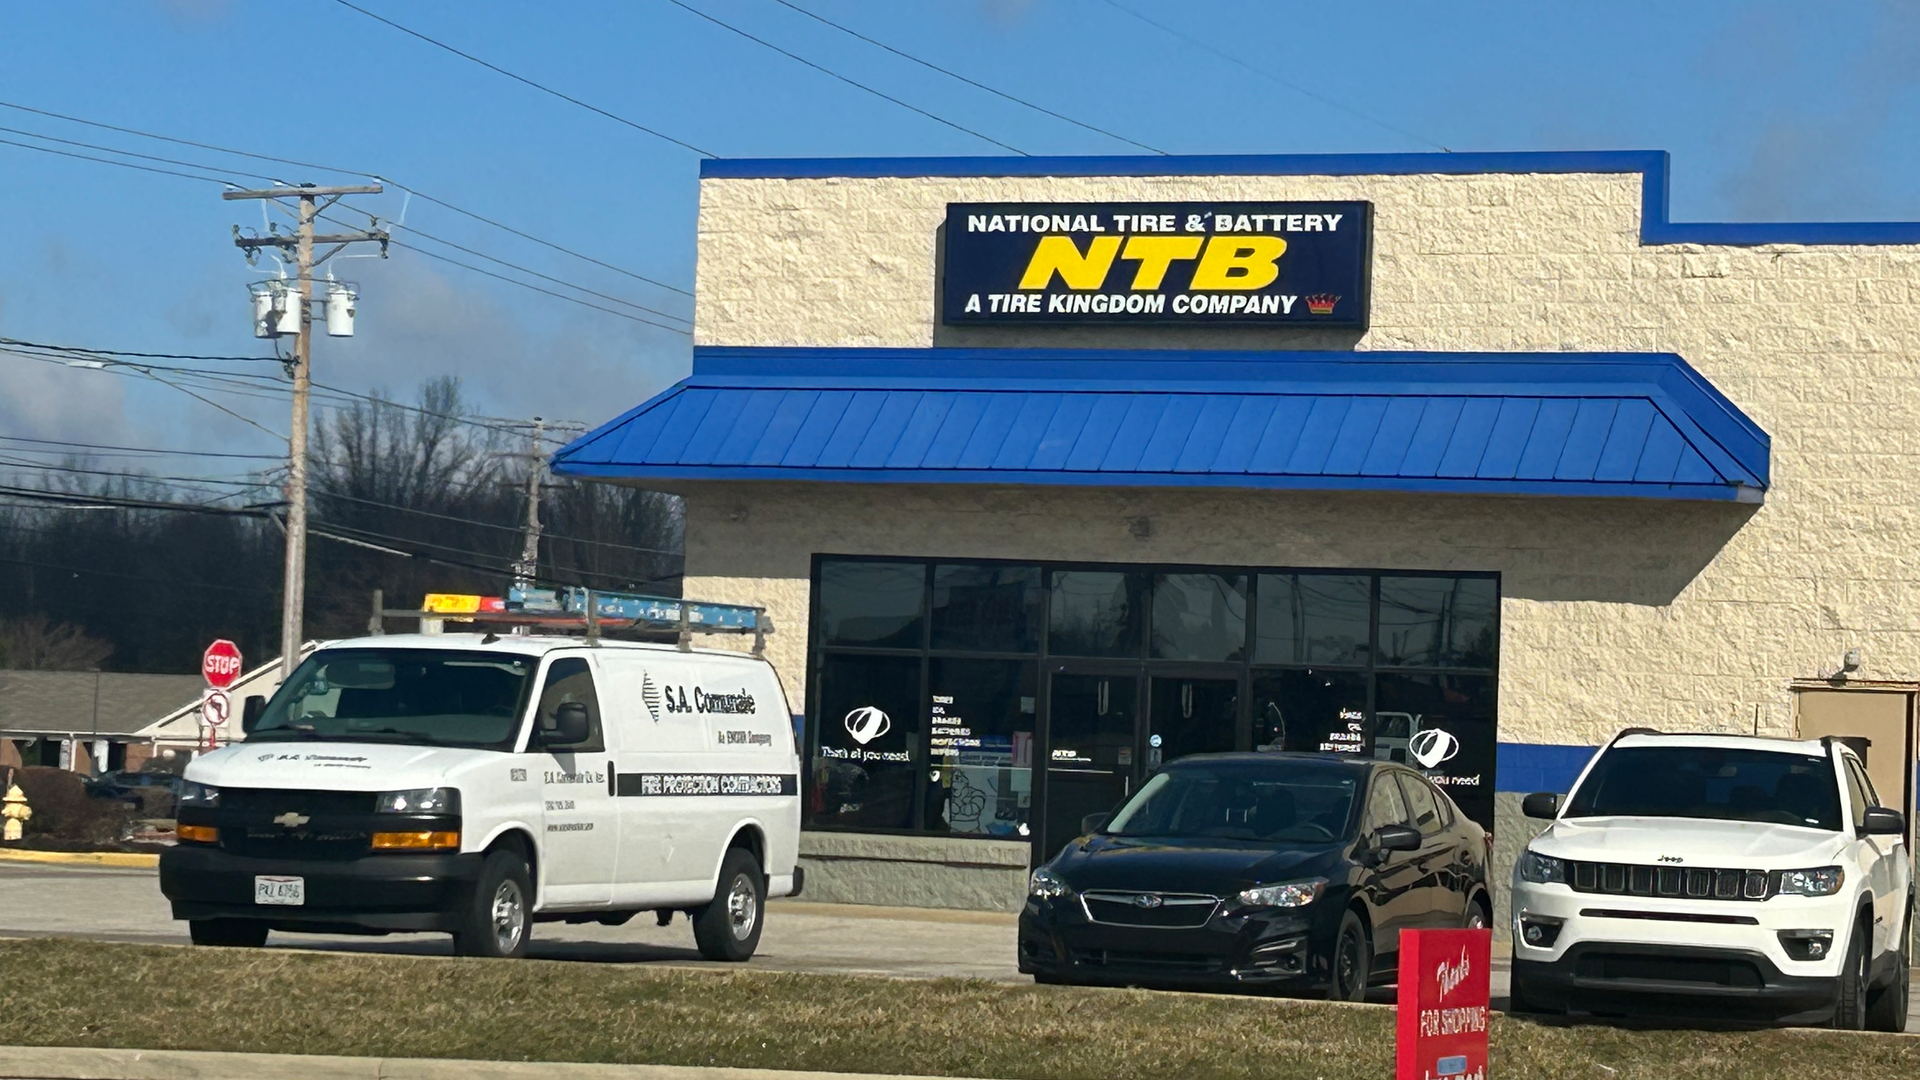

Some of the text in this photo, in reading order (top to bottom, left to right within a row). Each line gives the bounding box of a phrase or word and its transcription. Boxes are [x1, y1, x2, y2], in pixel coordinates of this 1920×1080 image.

[967, 213, 1344, 233] NATIONAL TIRE & BATTERY
[1018, 235, 1288, 291] NTB
[964, 293, 1298, 315] A TIRE KINGDOM COMPANY
[206, 654, 240, 675] STOP
[664, 685, 692, 714] S.A.
[663, 775, 720, 794] PROTECTION
[1420, 1006, 1486, 1037] FOR SHOPPING
